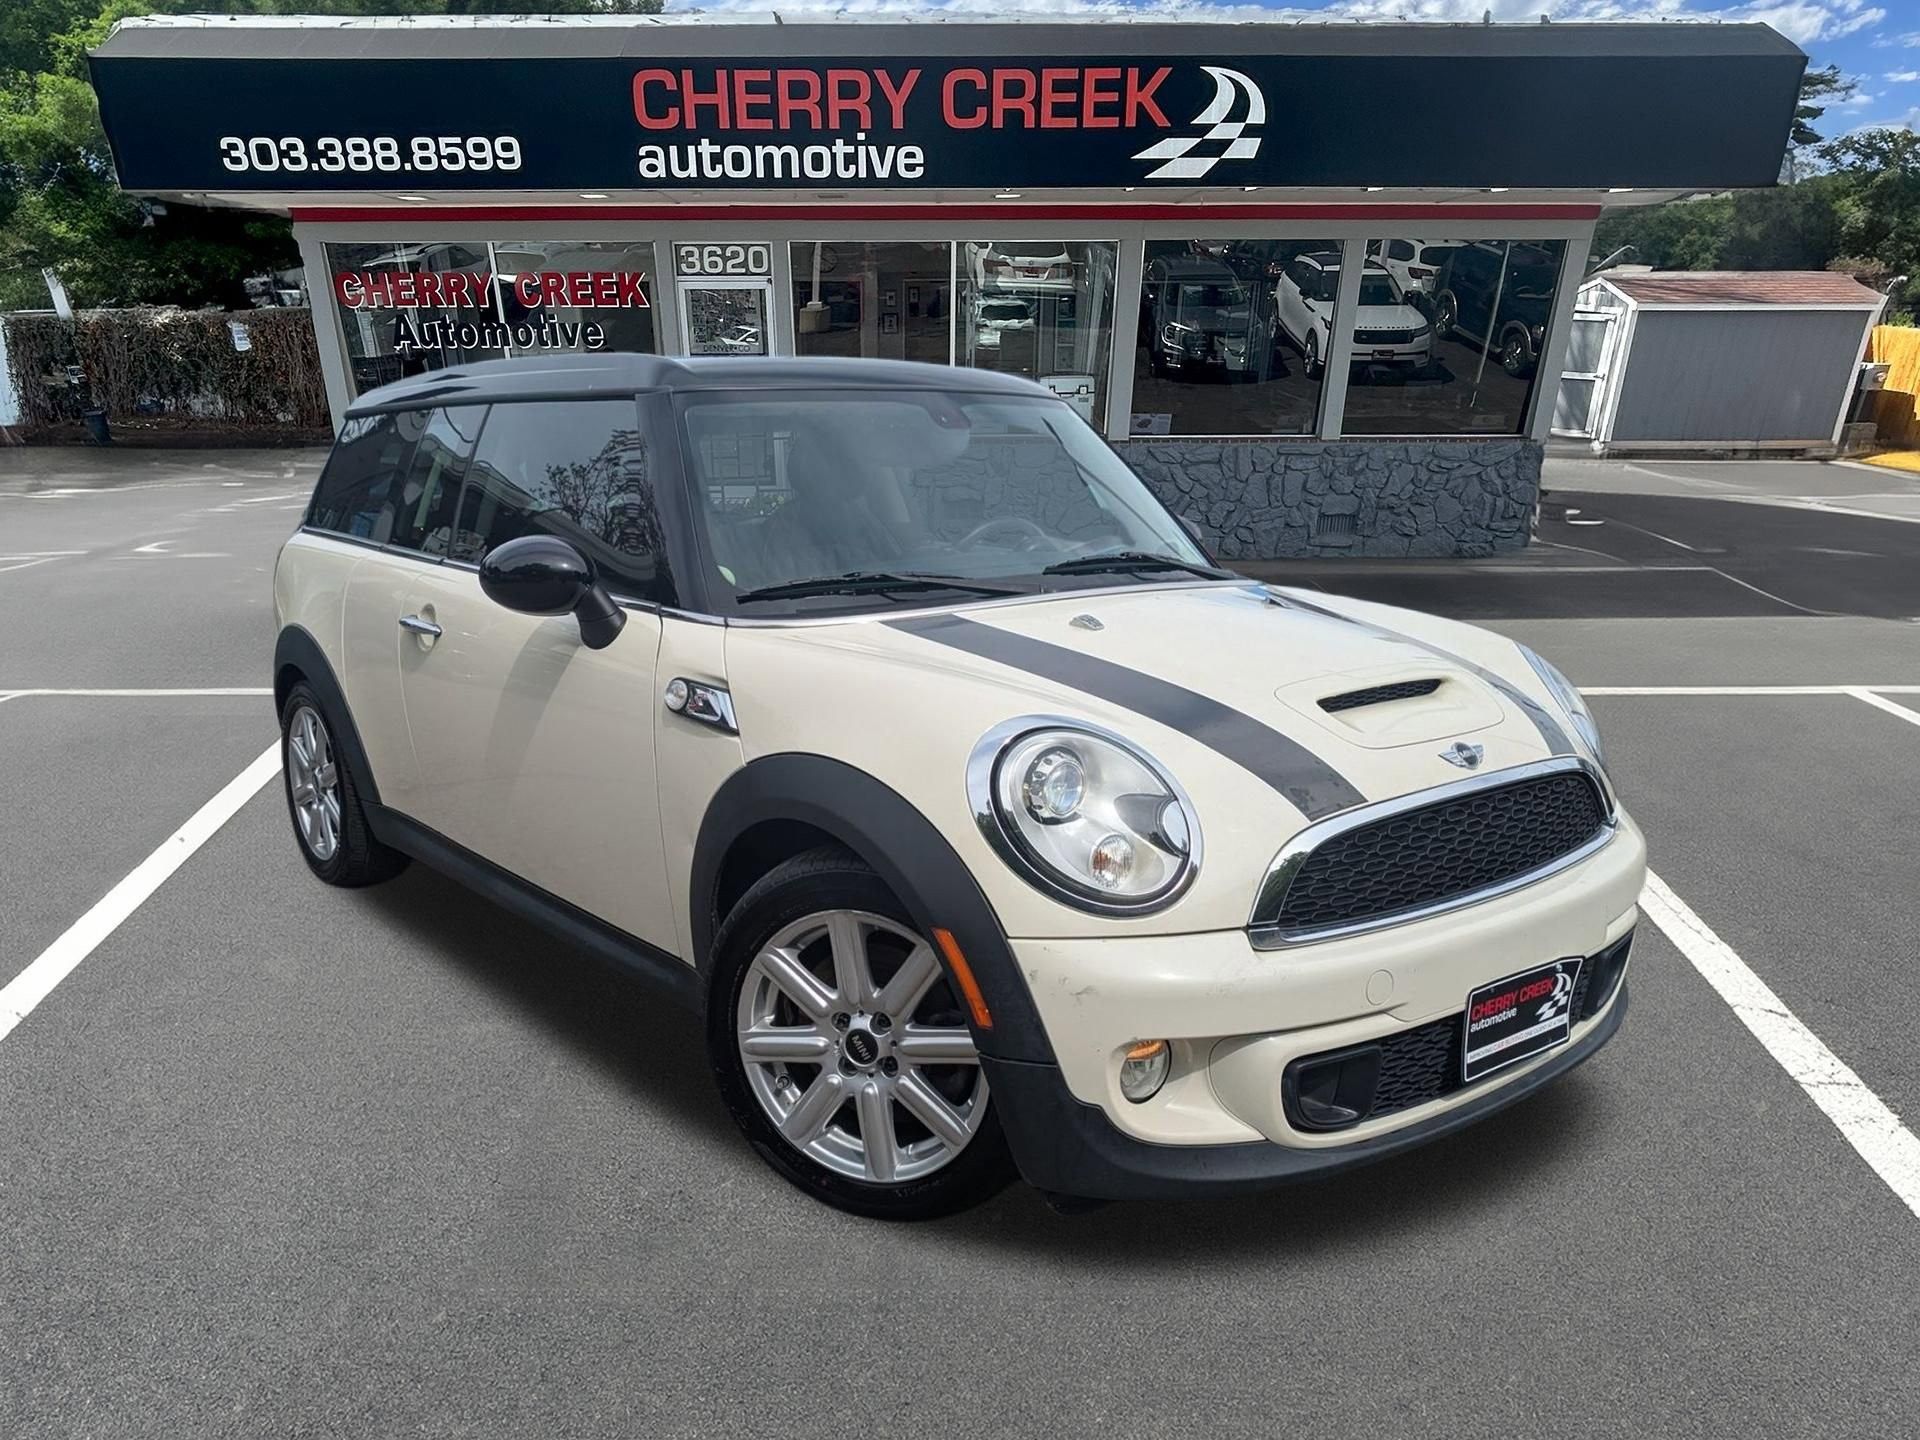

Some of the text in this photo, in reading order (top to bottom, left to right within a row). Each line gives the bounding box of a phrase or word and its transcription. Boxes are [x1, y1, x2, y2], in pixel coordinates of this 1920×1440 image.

[632, 66, 1173, 130] CHERRY CREEK
[219, 135, 522, 172] 303.388.8599
[638, 132, 925, 180] automotive
[680, 245, 769, 274] 3620
[335, 271, 650, 310] CHERRY CREEK
[393, 313, 607, 350] Automotive
[1471, 976, 1555, 1021] CHERRY CREEK
[1470, 1006, 1518, 1033] automotive
[851, 1034, 872, 1061] MINI
